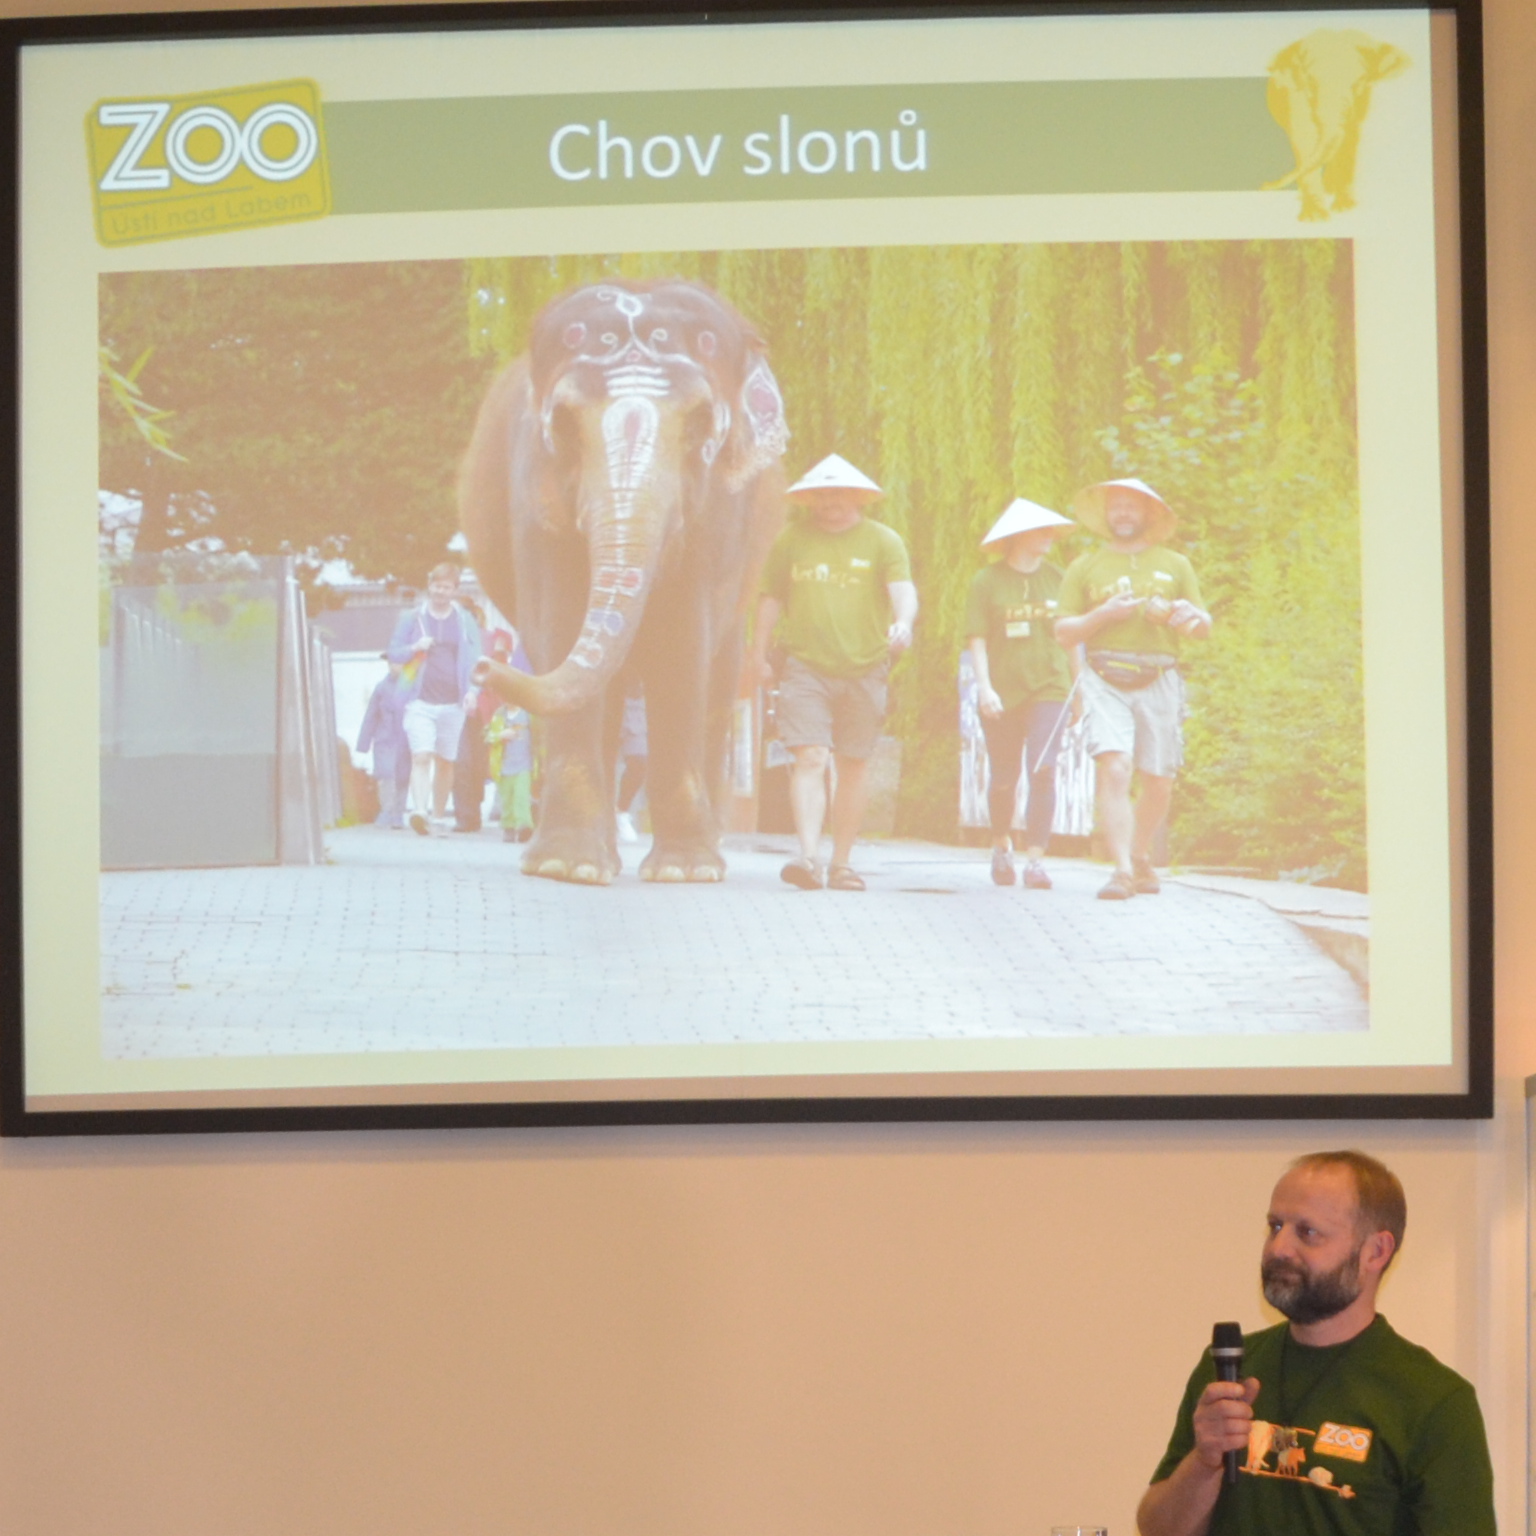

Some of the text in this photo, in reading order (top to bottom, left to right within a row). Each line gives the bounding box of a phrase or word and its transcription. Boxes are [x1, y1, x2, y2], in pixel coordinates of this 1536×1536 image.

[98, 102, 319, 190] ZOO
[549, 109, 927, 181] Chov slonů
[167, 202, 216, 228] nad
[225, 191, 312, 219] Labem
[1319, 1423, 1370, 1451] ZOO
